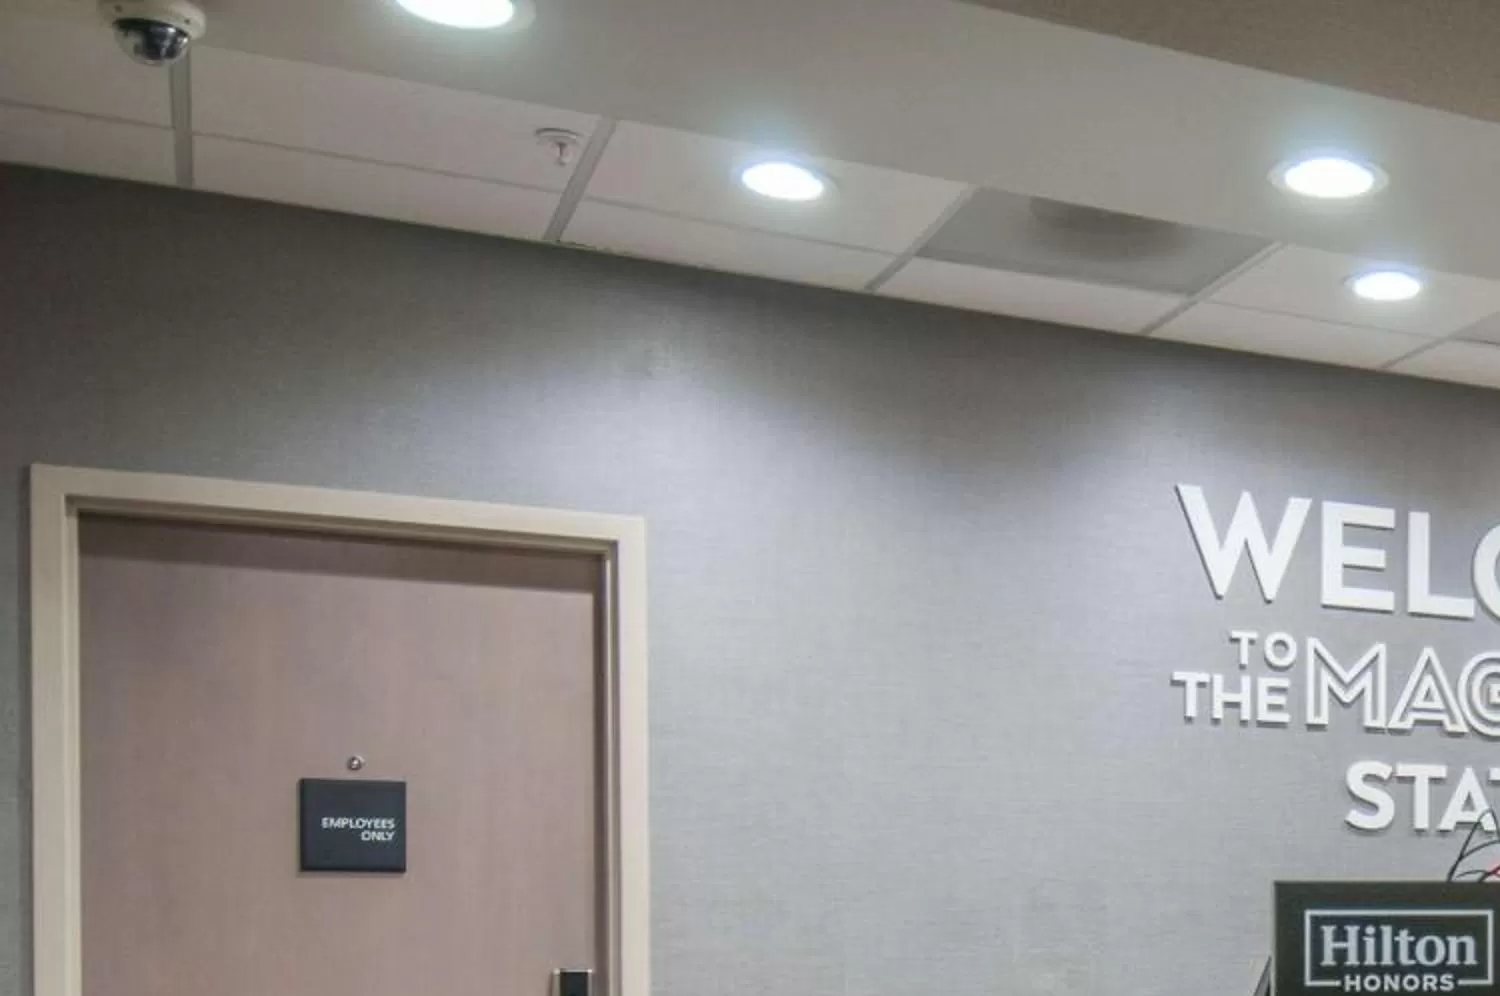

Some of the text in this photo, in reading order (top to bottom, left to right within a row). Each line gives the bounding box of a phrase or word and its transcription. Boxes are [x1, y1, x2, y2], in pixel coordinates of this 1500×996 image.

[1230, 630, 1297, 668] TO
[1171, 671, 1292, 724] THE
[321, 817, 395, 829] EMPLOYEES
[361, 830, 395, 841] ONLY
[1320, 925, 1478, 967] Hilton
[1344, 974, 1456, 992] HONORS
